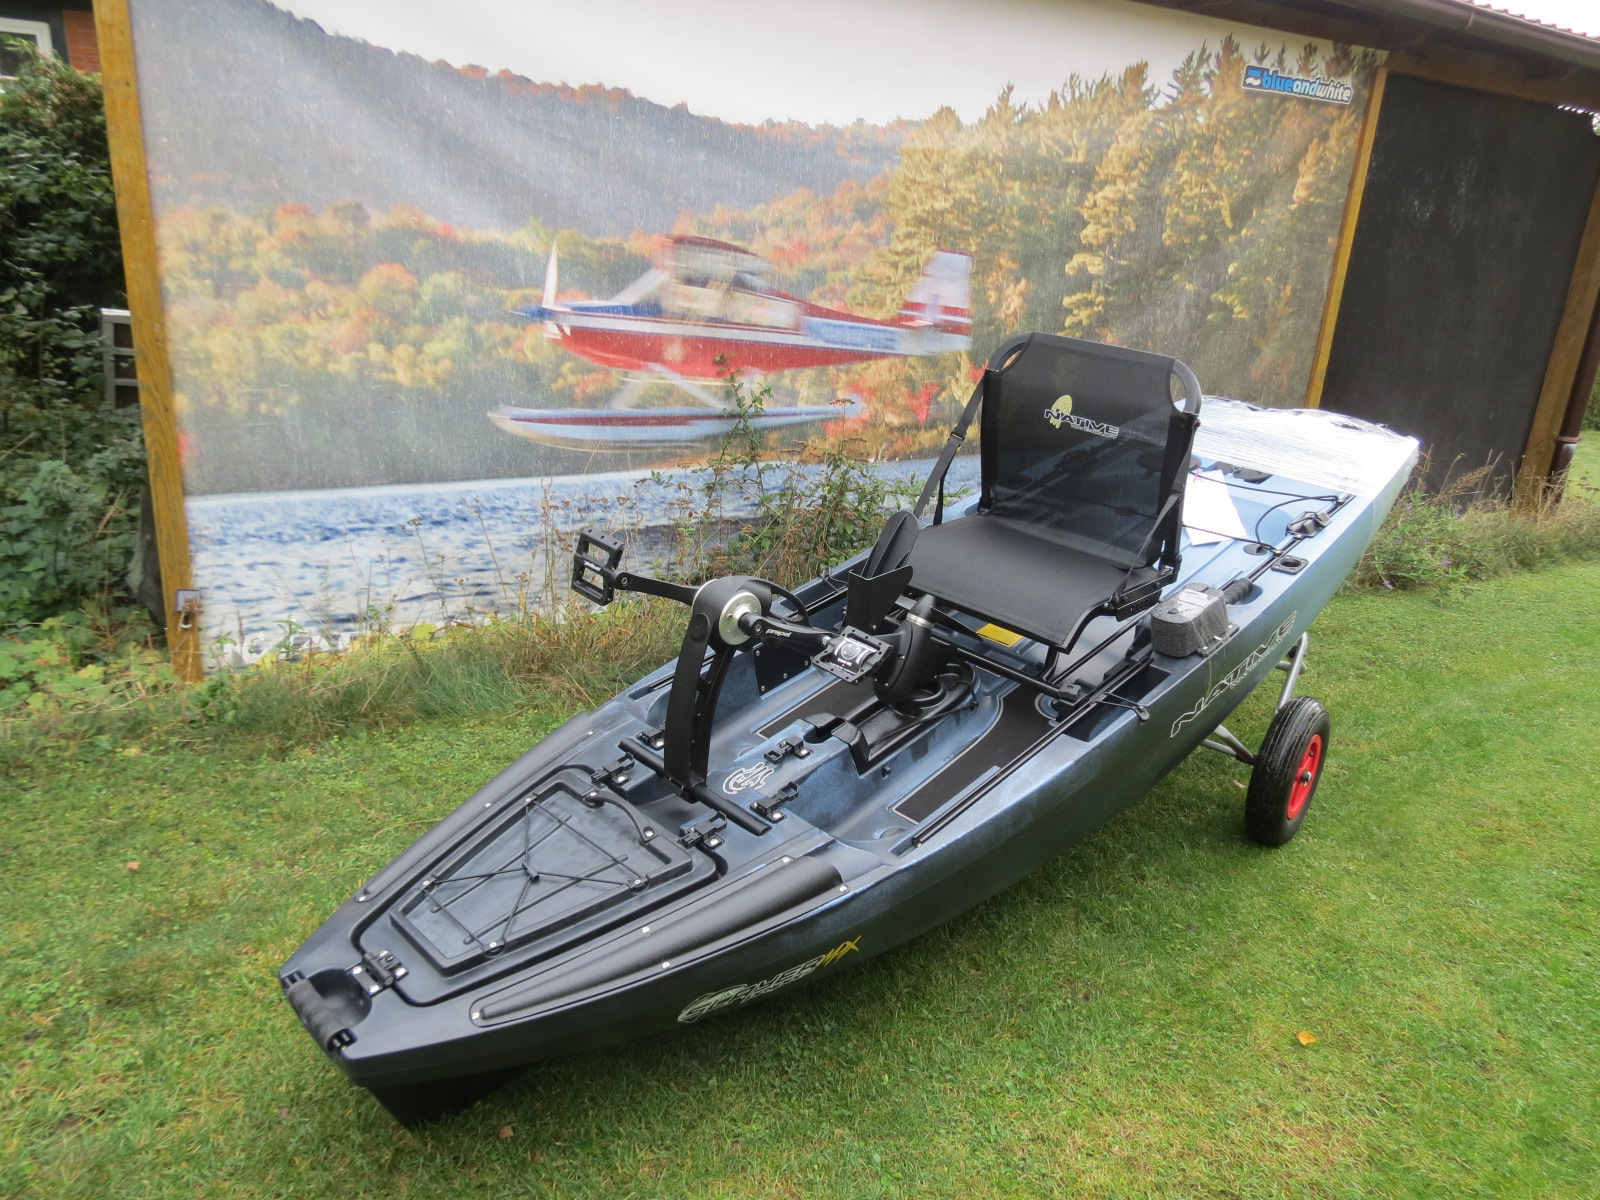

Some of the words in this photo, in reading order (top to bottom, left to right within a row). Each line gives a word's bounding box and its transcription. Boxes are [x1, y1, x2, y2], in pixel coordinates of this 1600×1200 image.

[1262, 70, 1352, 101] blueandwhite
[1044, 409, 1119, 436] NATIVE
[1170, 610, 1297, 738] NATIVE
